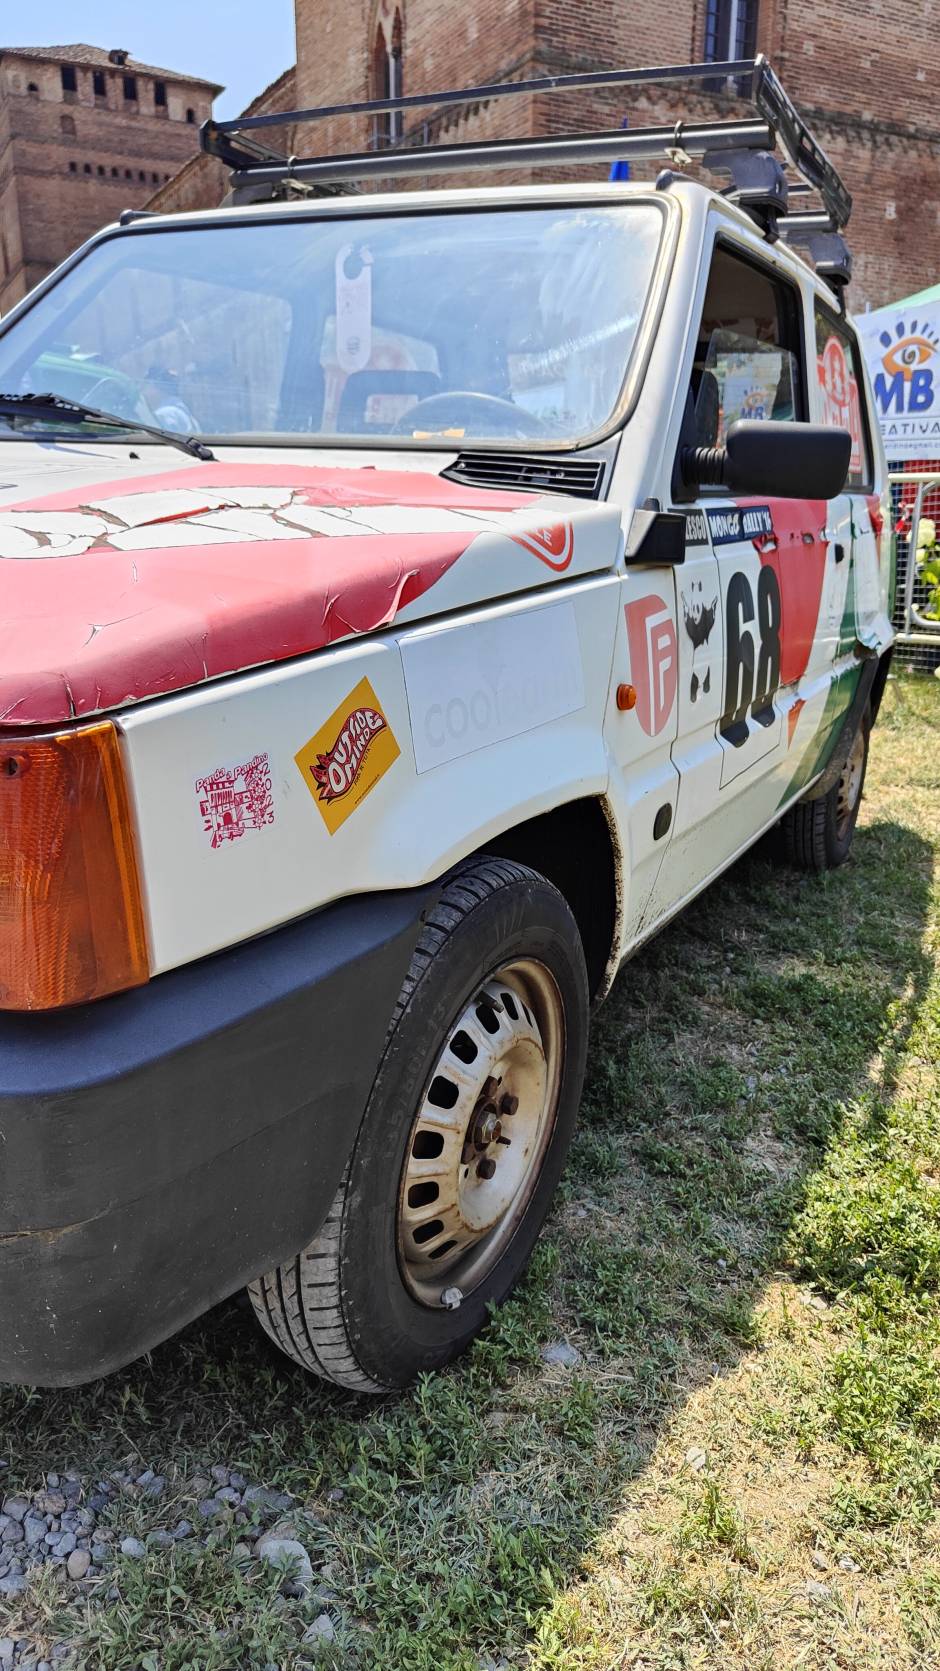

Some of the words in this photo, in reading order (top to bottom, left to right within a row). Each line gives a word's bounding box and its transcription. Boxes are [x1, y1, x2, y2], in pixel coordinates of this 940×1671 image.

[873, 369, 934, 415] MB
[720, 565, 781, 748] 68
[195, 768, 225, 794] Panda
[233, 752, 268, 779] Pandino
[326, 710, 384, 793] OUTSIDE
[346, 727, 370, 782] MIND
